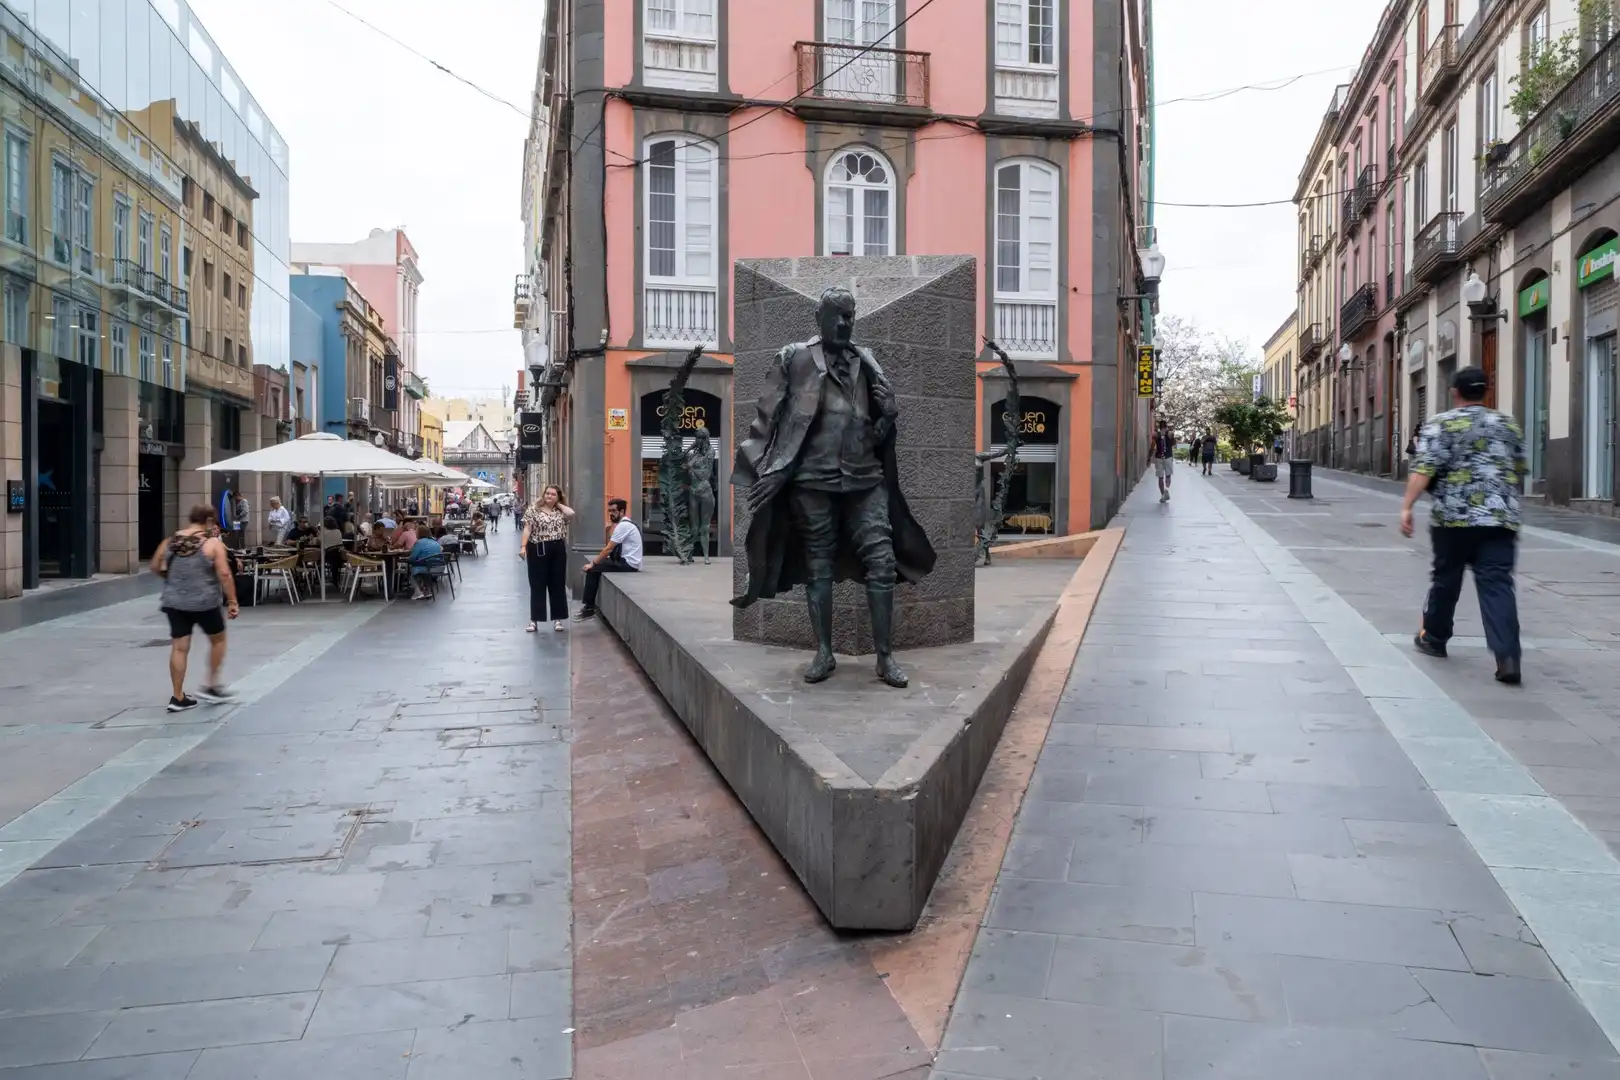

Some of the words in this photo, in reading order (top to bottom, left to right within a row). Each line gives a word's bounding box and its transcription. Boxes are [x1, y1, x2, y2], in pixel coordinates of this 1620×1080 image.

[1139, 365, 1153, 393] KING
[677, 415, 706, 429] usto
[1019, 420, 1046, 433] usto
